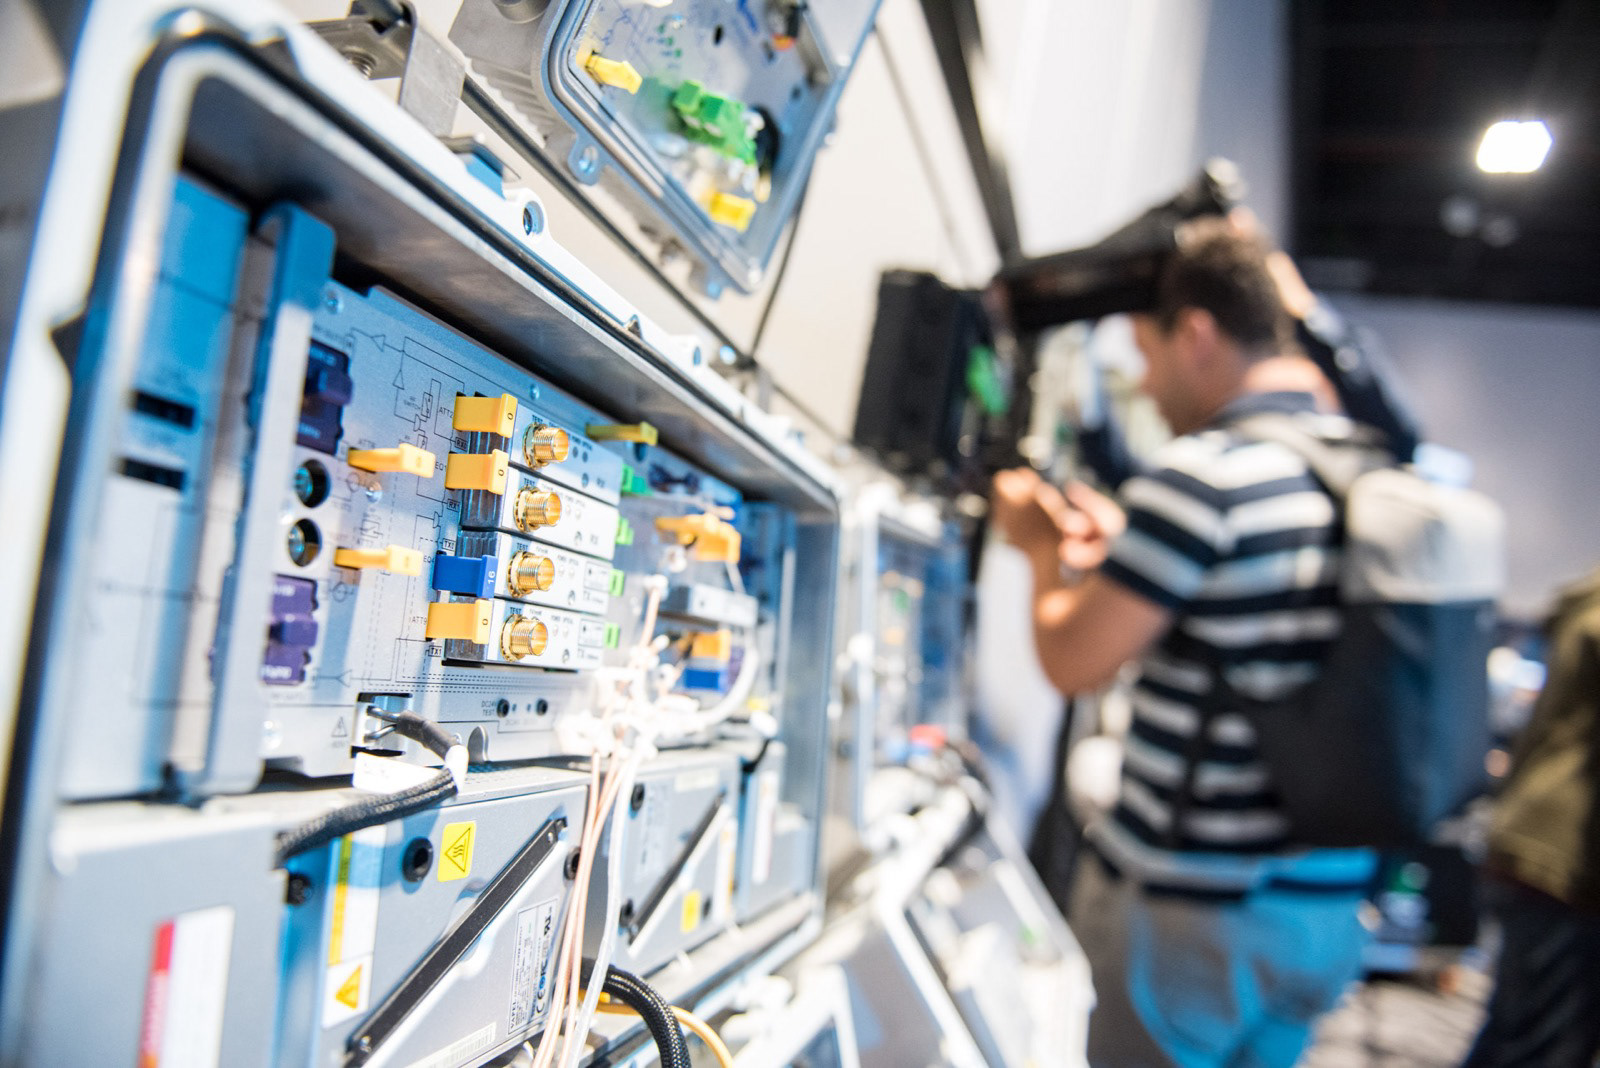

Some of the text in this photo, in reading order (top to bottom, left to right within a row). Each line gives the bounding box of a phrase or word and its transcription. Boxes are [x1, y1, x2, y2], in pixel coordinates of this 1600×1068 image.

[516, 543, 528, 552] TEST
[488, 570, 496, 584] 16
[510, 607, 522, 615] TEST
[431, 647, 442, 656] TX1
